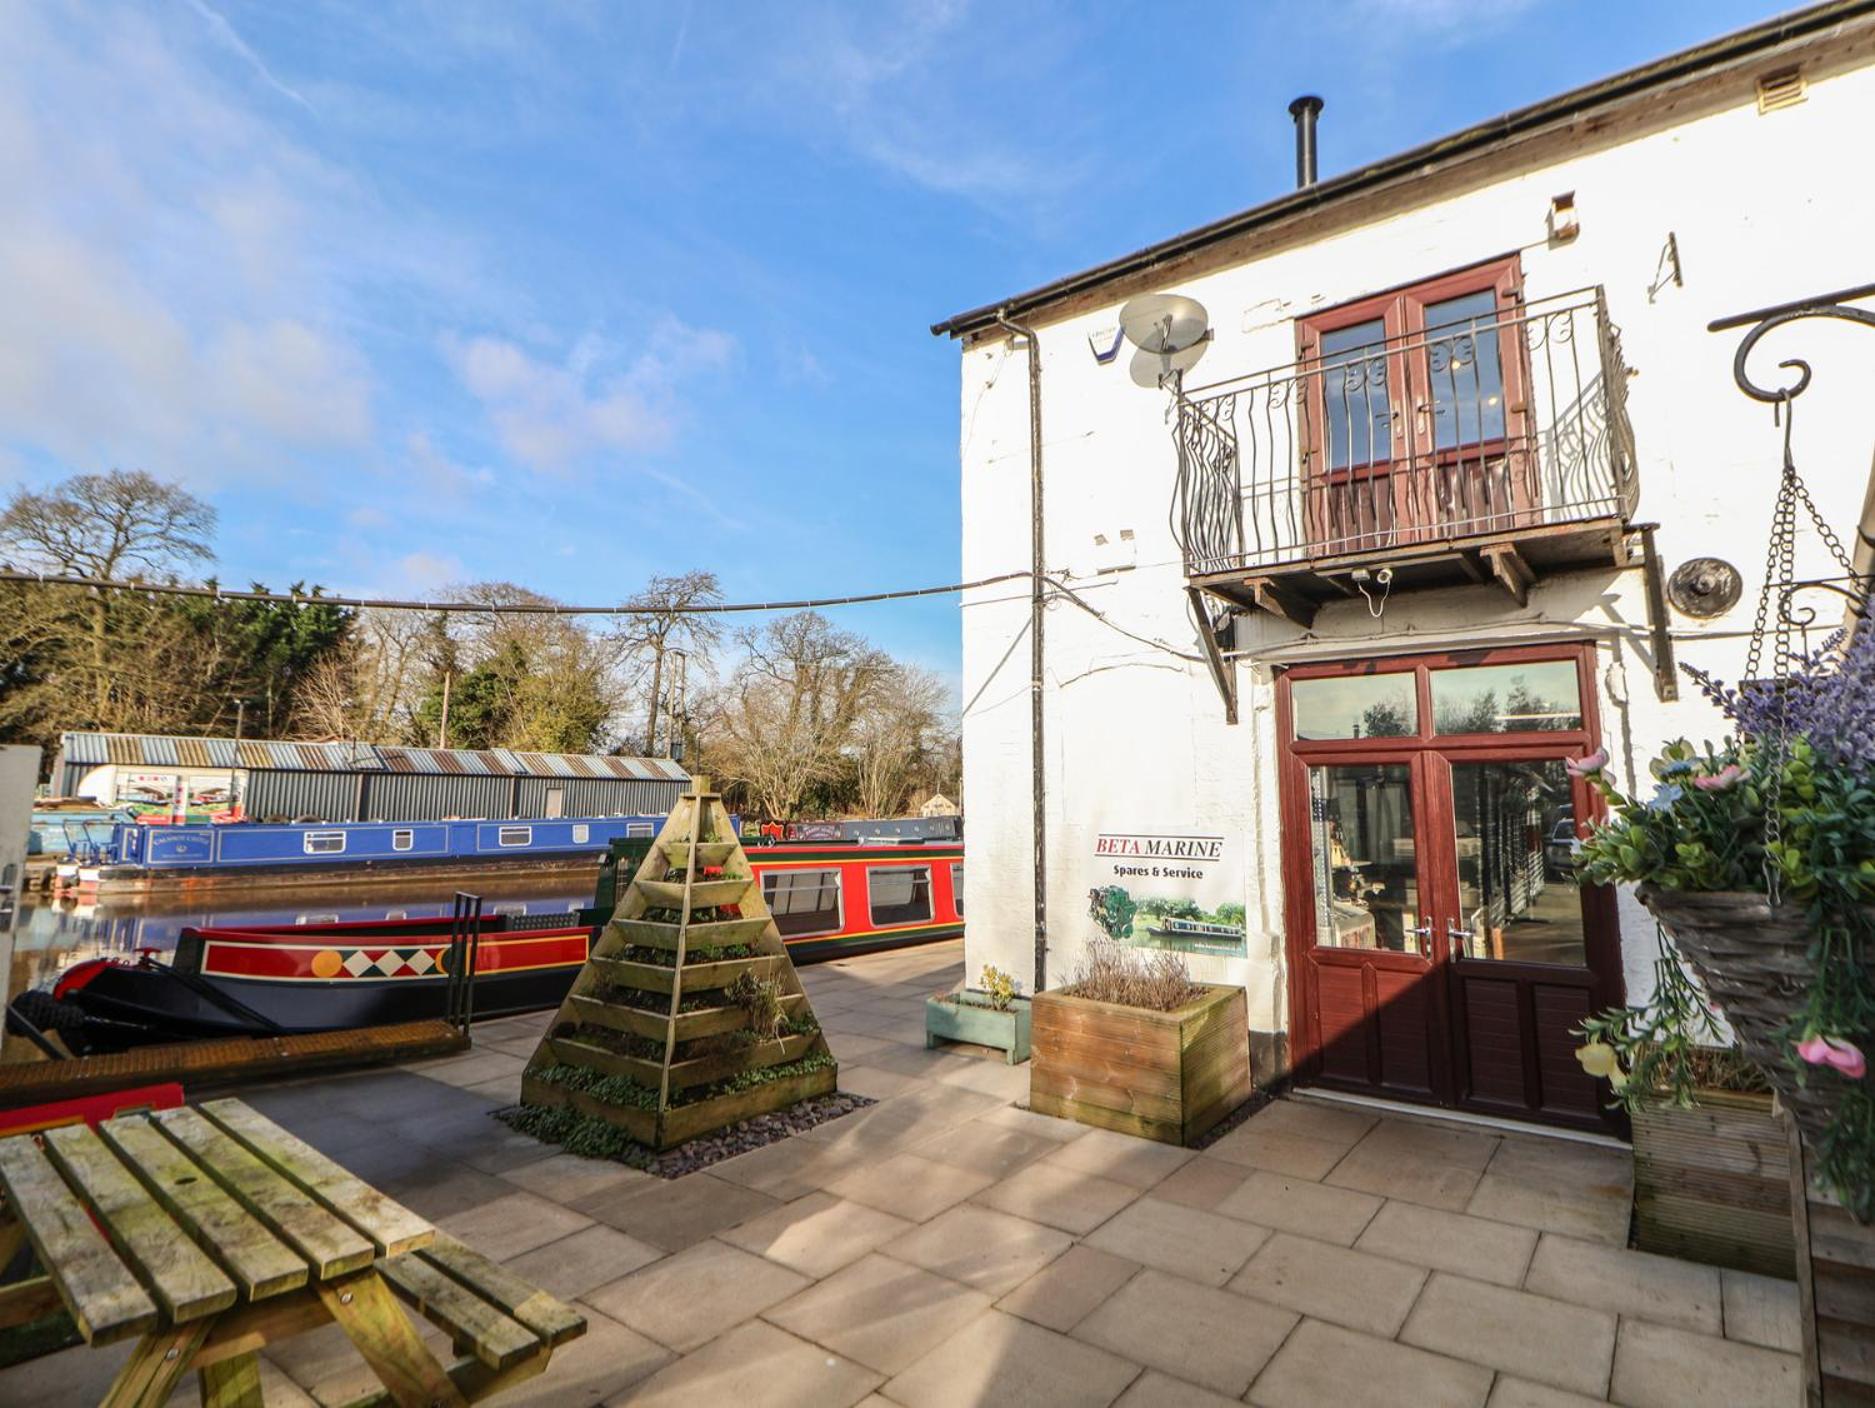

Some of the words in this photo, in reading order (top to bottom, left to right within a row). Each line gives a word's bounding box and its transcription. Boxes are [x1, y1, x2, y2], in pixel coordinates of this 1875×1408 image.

[1096, 838, 1140, 854] BETA
[1144, 839, 1223, 858] MARINE
[1113, 864, 1149, 877] Spares
[1152, 867, 1160, 877] &
[1163, 867, 1203, 879] Service
